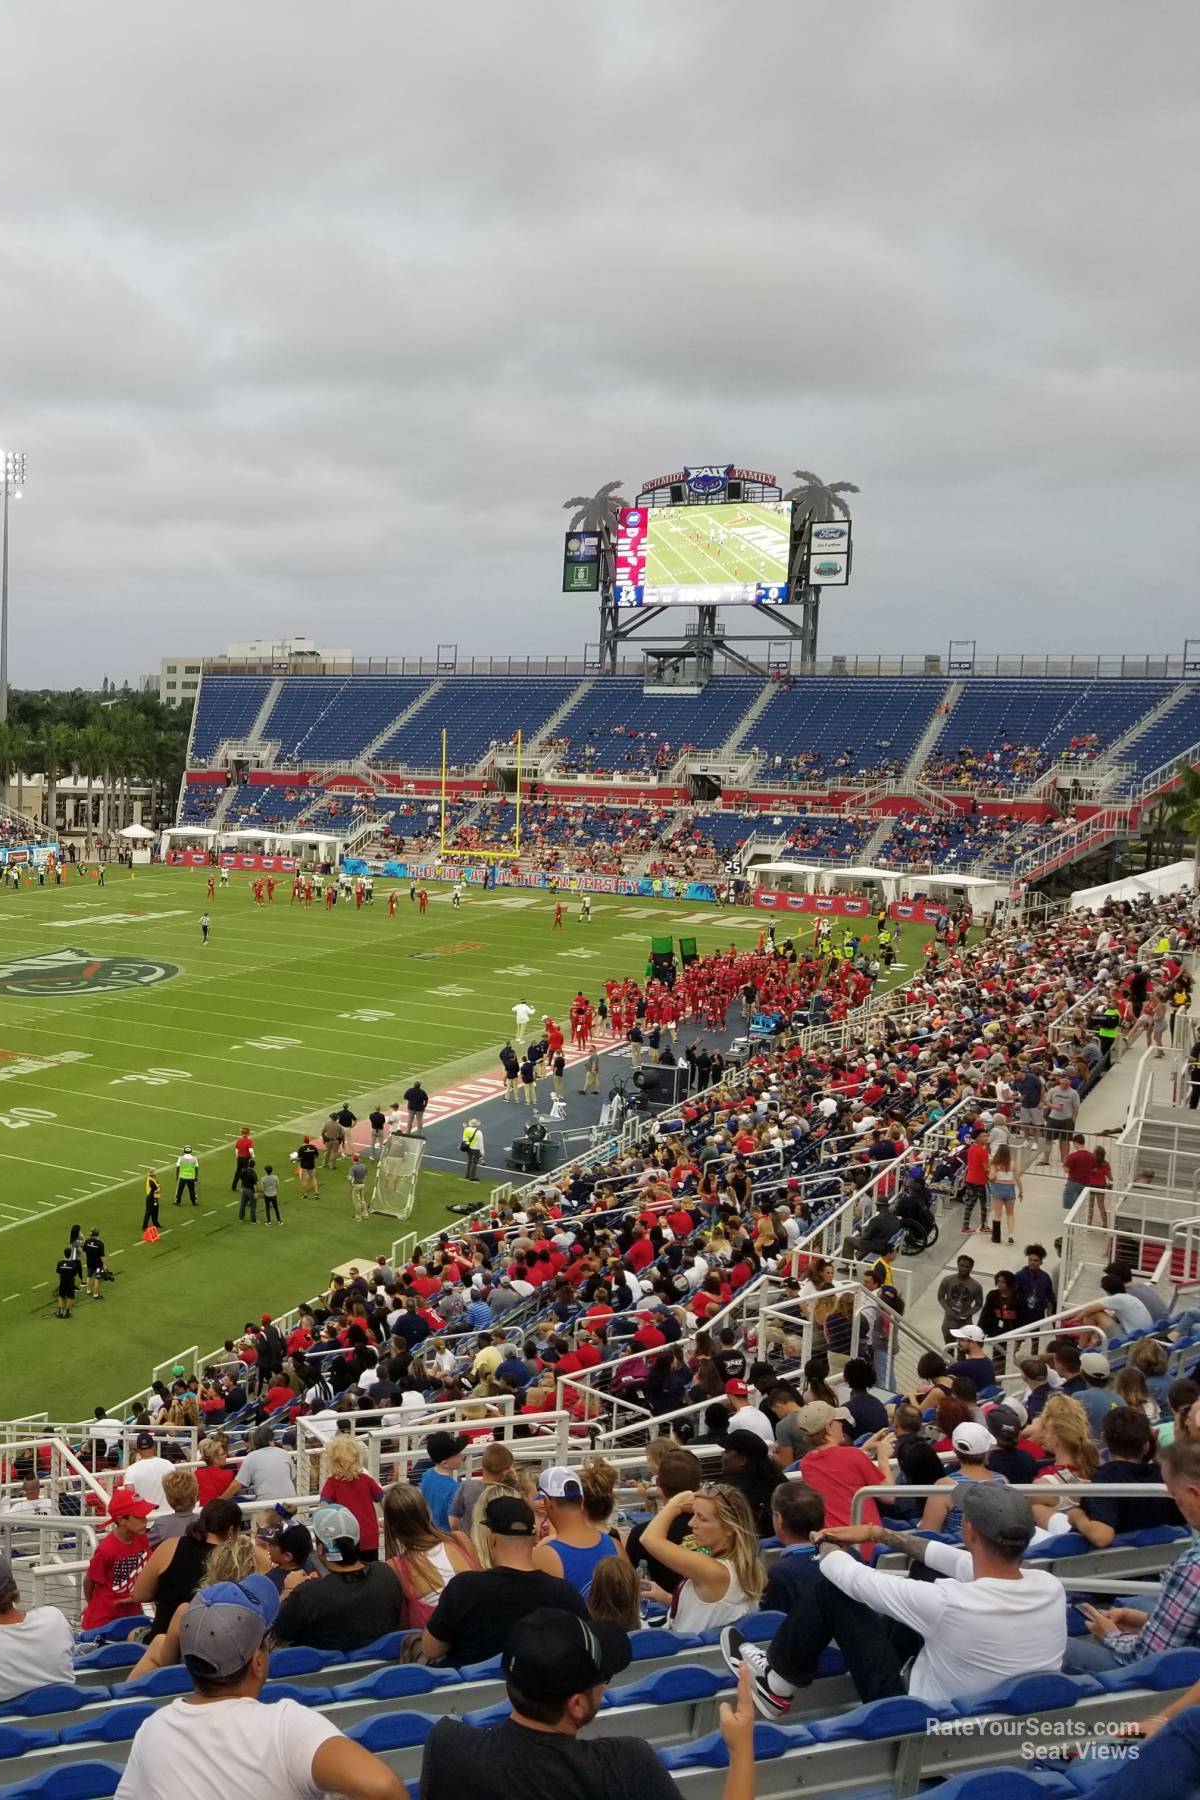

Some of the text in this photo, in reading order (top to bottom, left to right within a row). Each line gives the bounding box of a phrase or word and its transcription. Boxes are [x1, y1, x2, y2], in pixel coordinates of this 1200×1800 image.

[643, 469, 774, 491] SCHMIDT FAMILY
[689, 467, 727, 480] FAU
[818, 528, 841, 538] Ford
[725, 861, 740, 873] 25
[409, 865, 465, 879] FLOIDA
[470, 870, 543, 886] ATANTIC
[337, 1008, 396, 1022] 50
[245, 1036, 303, 1050] 40
[123, 1067, 193, 1086] 30
